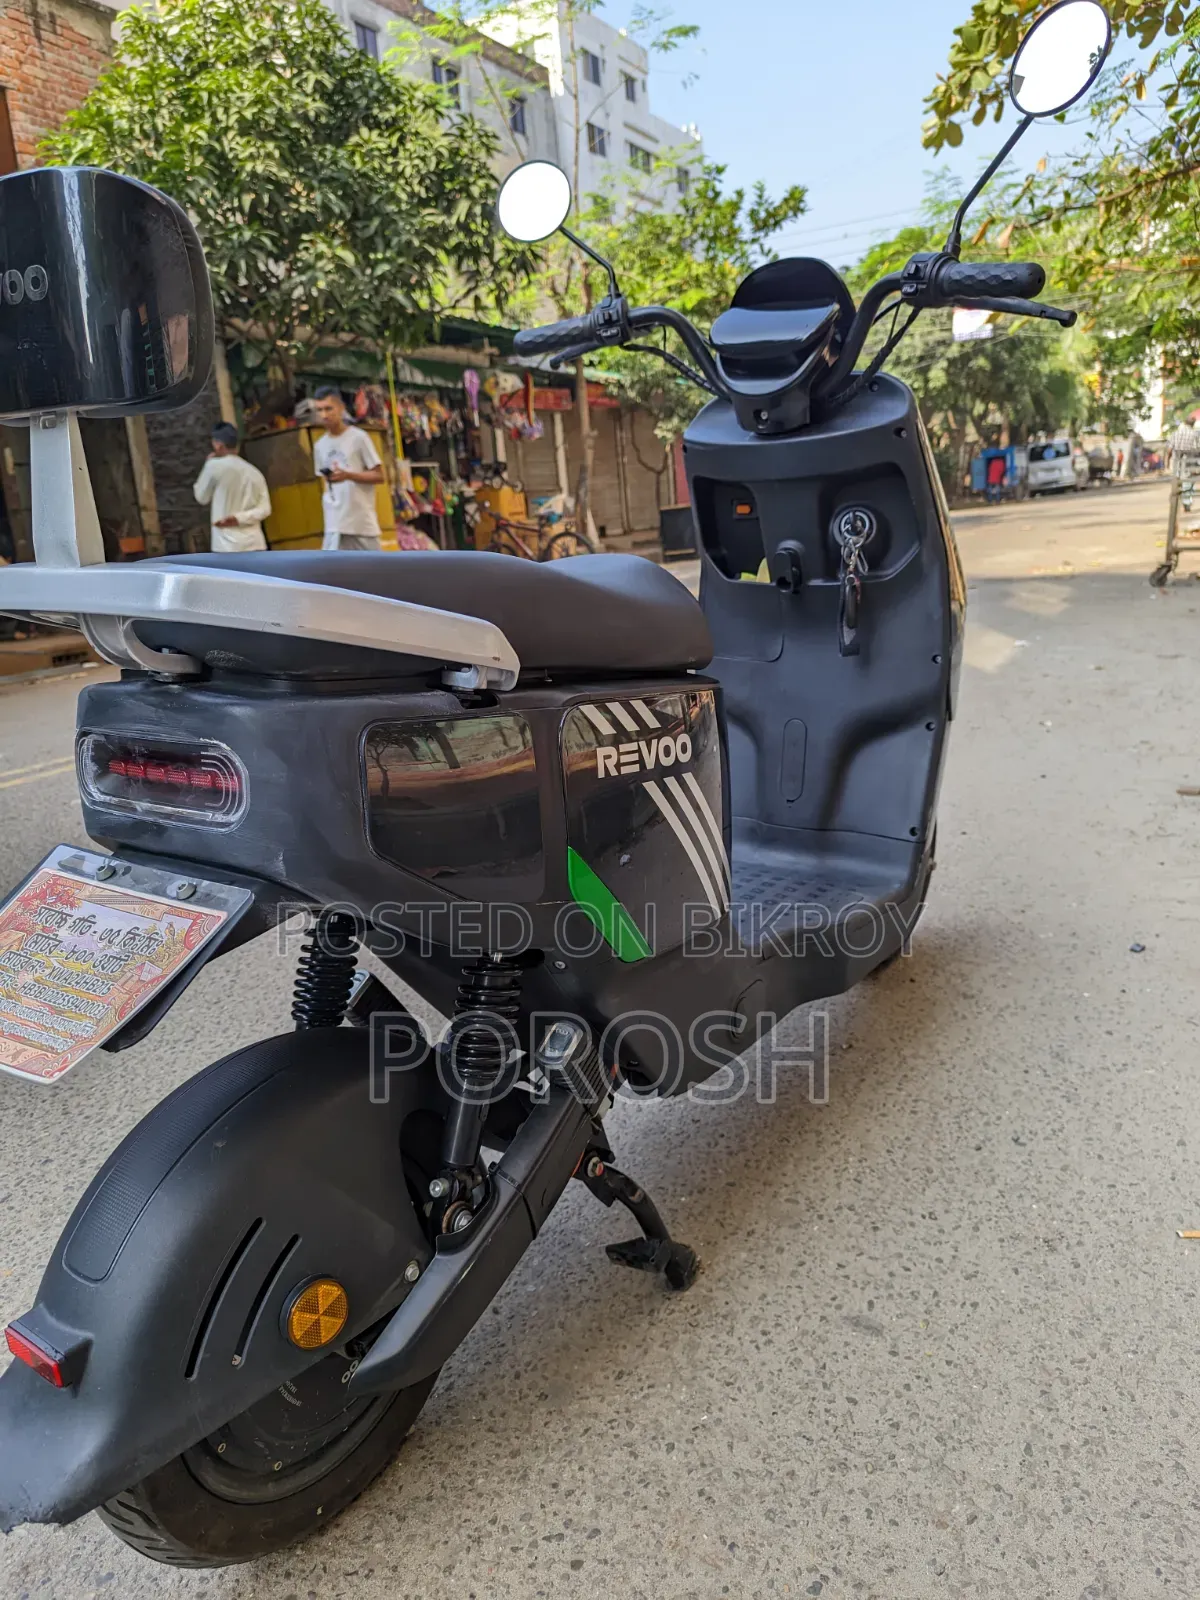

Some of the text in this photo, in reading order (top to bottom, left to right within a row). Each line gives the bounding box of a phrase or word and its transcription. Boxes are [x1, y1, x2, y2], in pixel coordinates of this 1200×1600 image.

[596, 733, 692, 779] REVOO
[68, 914, 97, 936] গতি
[99, 928, 122, 945] ৩৫
[25, 932, 63, 955] মোটর
[64, 945, 96, 962] ৮০০
[92, 953, 131, 975] ওয়াট
[46, 965, 115, 996] XWA24HB215
